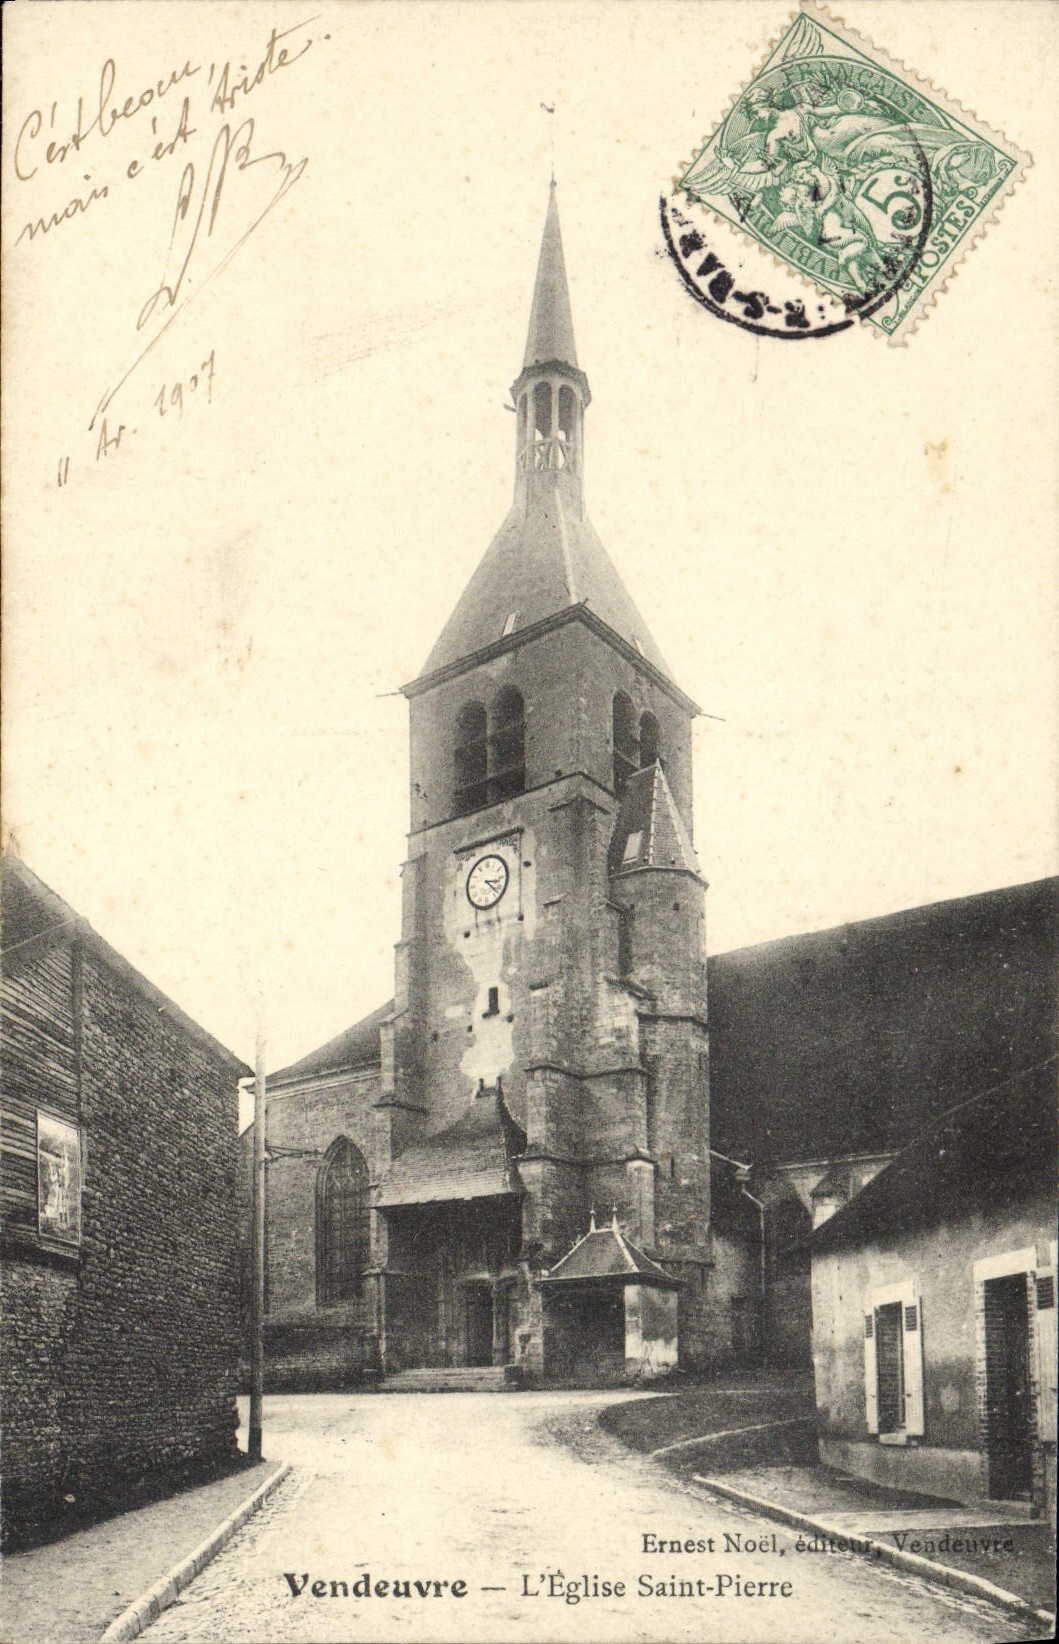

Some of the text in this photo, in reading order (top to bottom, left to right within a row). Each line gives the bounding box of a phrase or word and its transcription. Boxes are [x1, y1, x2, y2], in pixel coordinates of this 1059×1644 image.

[14, 173, 109, 248] mais
[909, 199, 978, 285] POSTES
[153, 348, 216, 422] 1907
